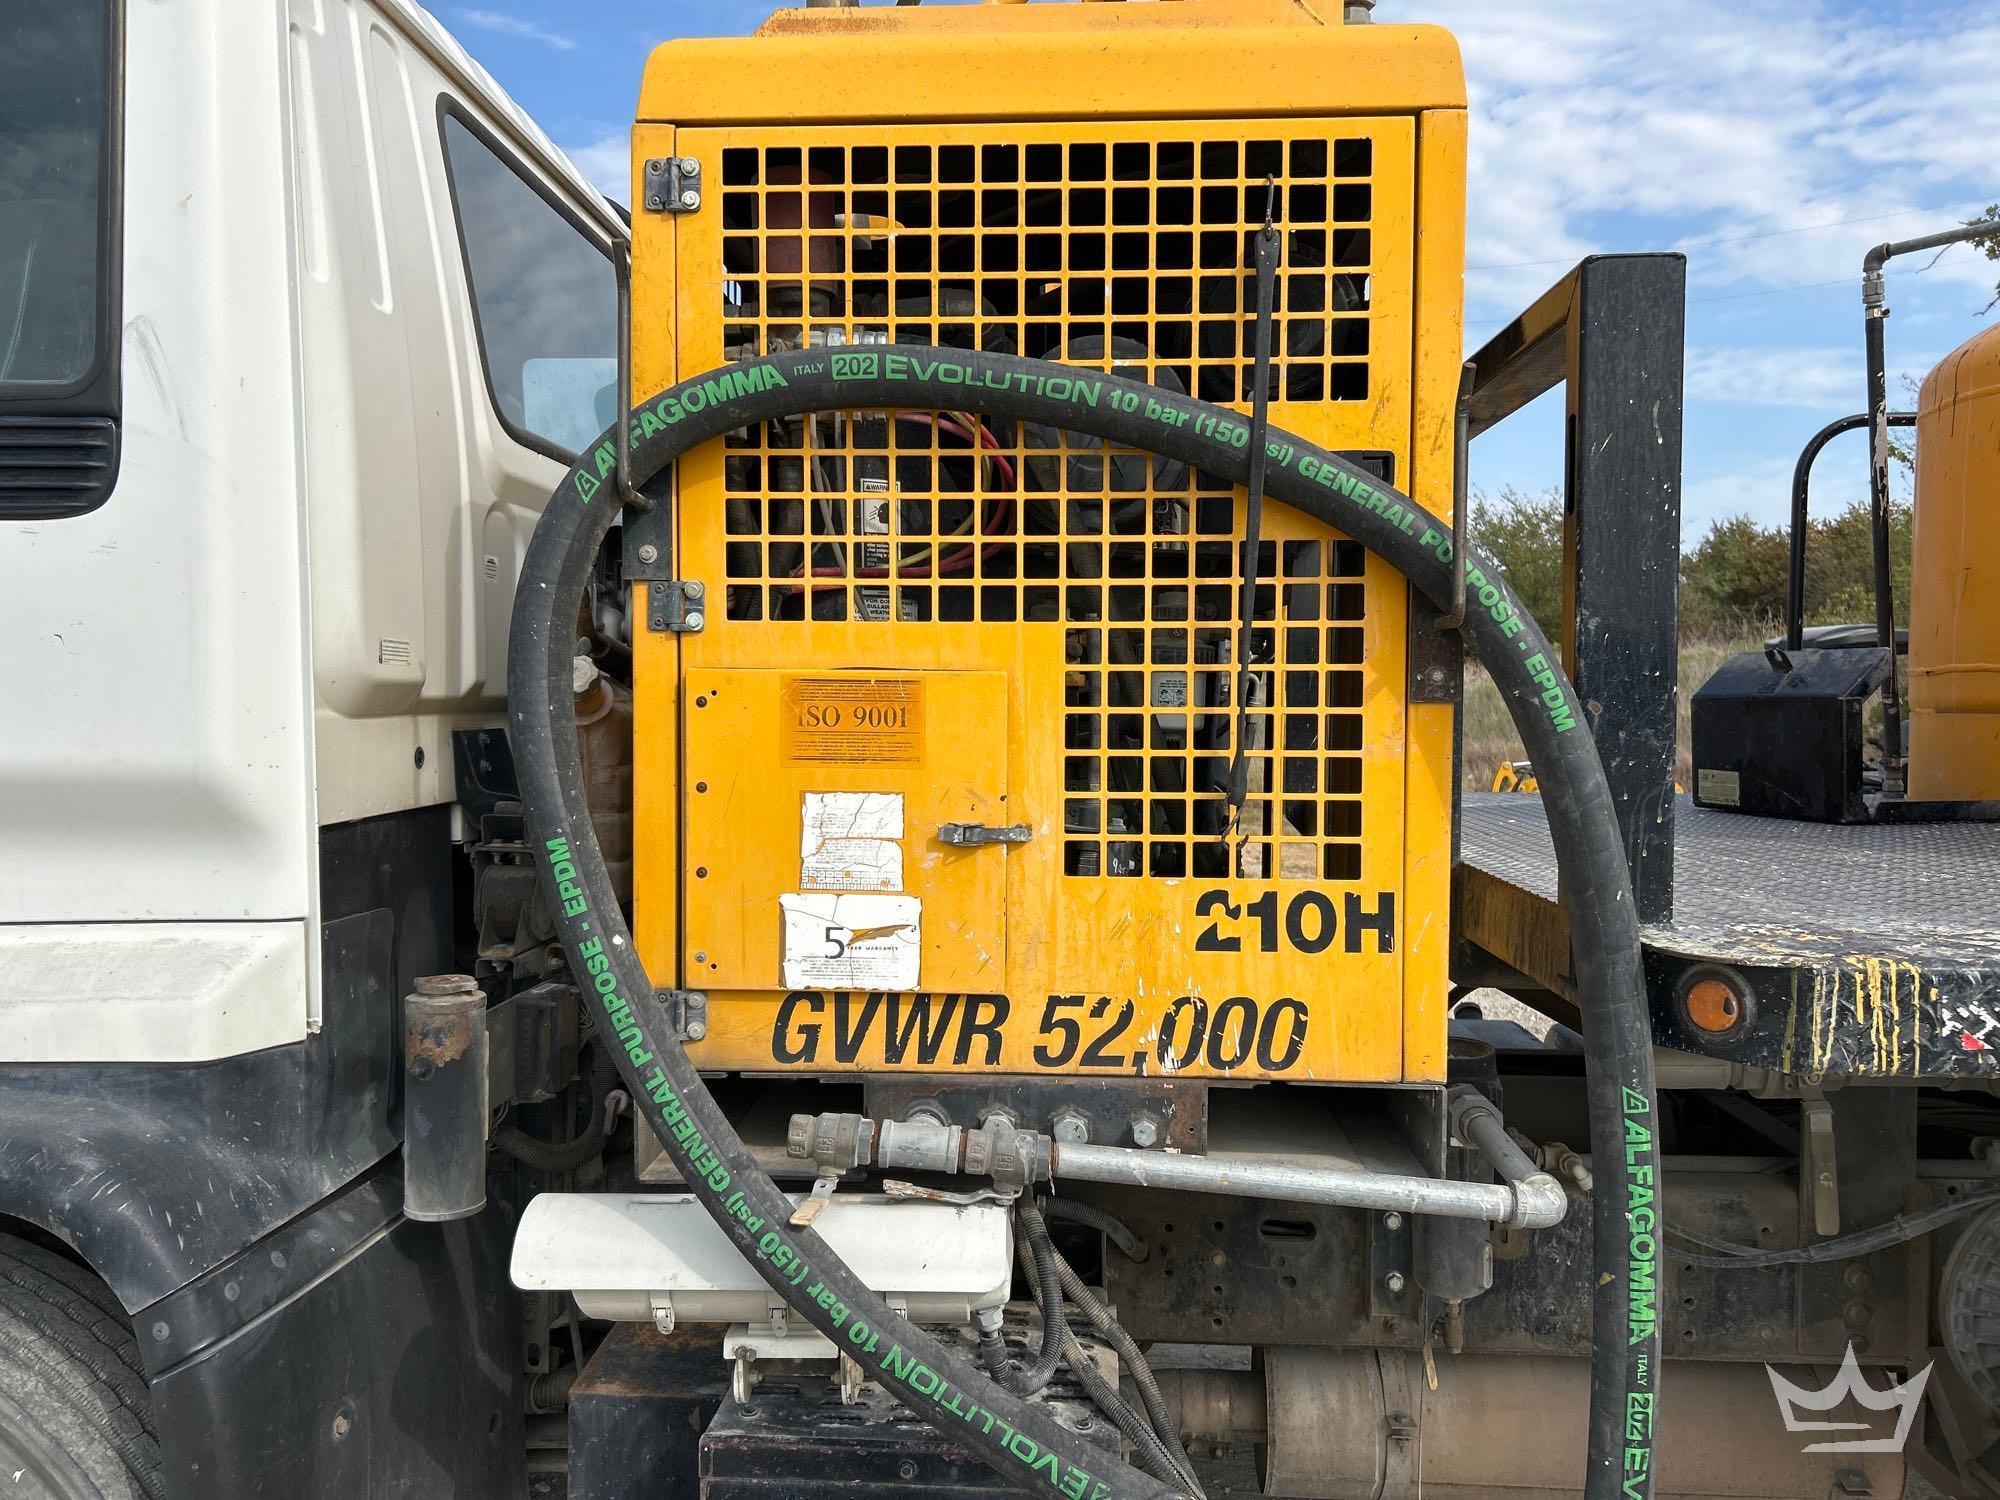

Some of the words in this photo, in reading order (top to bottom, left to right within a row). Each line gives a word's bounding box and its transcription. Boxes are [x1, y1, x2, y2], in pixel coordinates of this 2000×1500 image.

[793, 362, 824, 377] ITALY
[833, 354, 877, 379] 202
[885, 353, 1102, 408] EVOLUTION
[1109, 390, 1139, 415] 10
[1145, 397, 1192, 431] bar
[1195, 412, 1249, 448] (150
[1264, 441, 1295, 468] si)
[1298, 455, 1417, 538] GENERAL
[1418, 527, 1527, 640] PUPOSE
[1524, 650, 1578, 735] EPDM
[797, 705, 841, 728] ISO
[853, 706, 908, 728] 9001
[545, 835, 588, 919] EPDM
[824, 926, 845, 959] 5
[1195, 890, 1397, 954] 210H
[578, 935, 654, 1070] PURPOSE
[771, 992, 1010, 1066] GVWR
[1032, 994, 1309, 1076] 52,000
[643, 1065, 735, 1194] GENERAL
[724, 1190, 767, 1234] psi)
[1622, 1117, 1658, 1347] ALFAGOMMA
[759, 1231, 811, 1287] (150
[806, 1282, 850, 1330] bar
[847, 1321, 881, 1354] 10
[1637, 1353, 1649, 1387] ITALY
[879, 1343, 1090, 1500] EVOLUTION
[1627, 1393, 1652, 1440] 202
